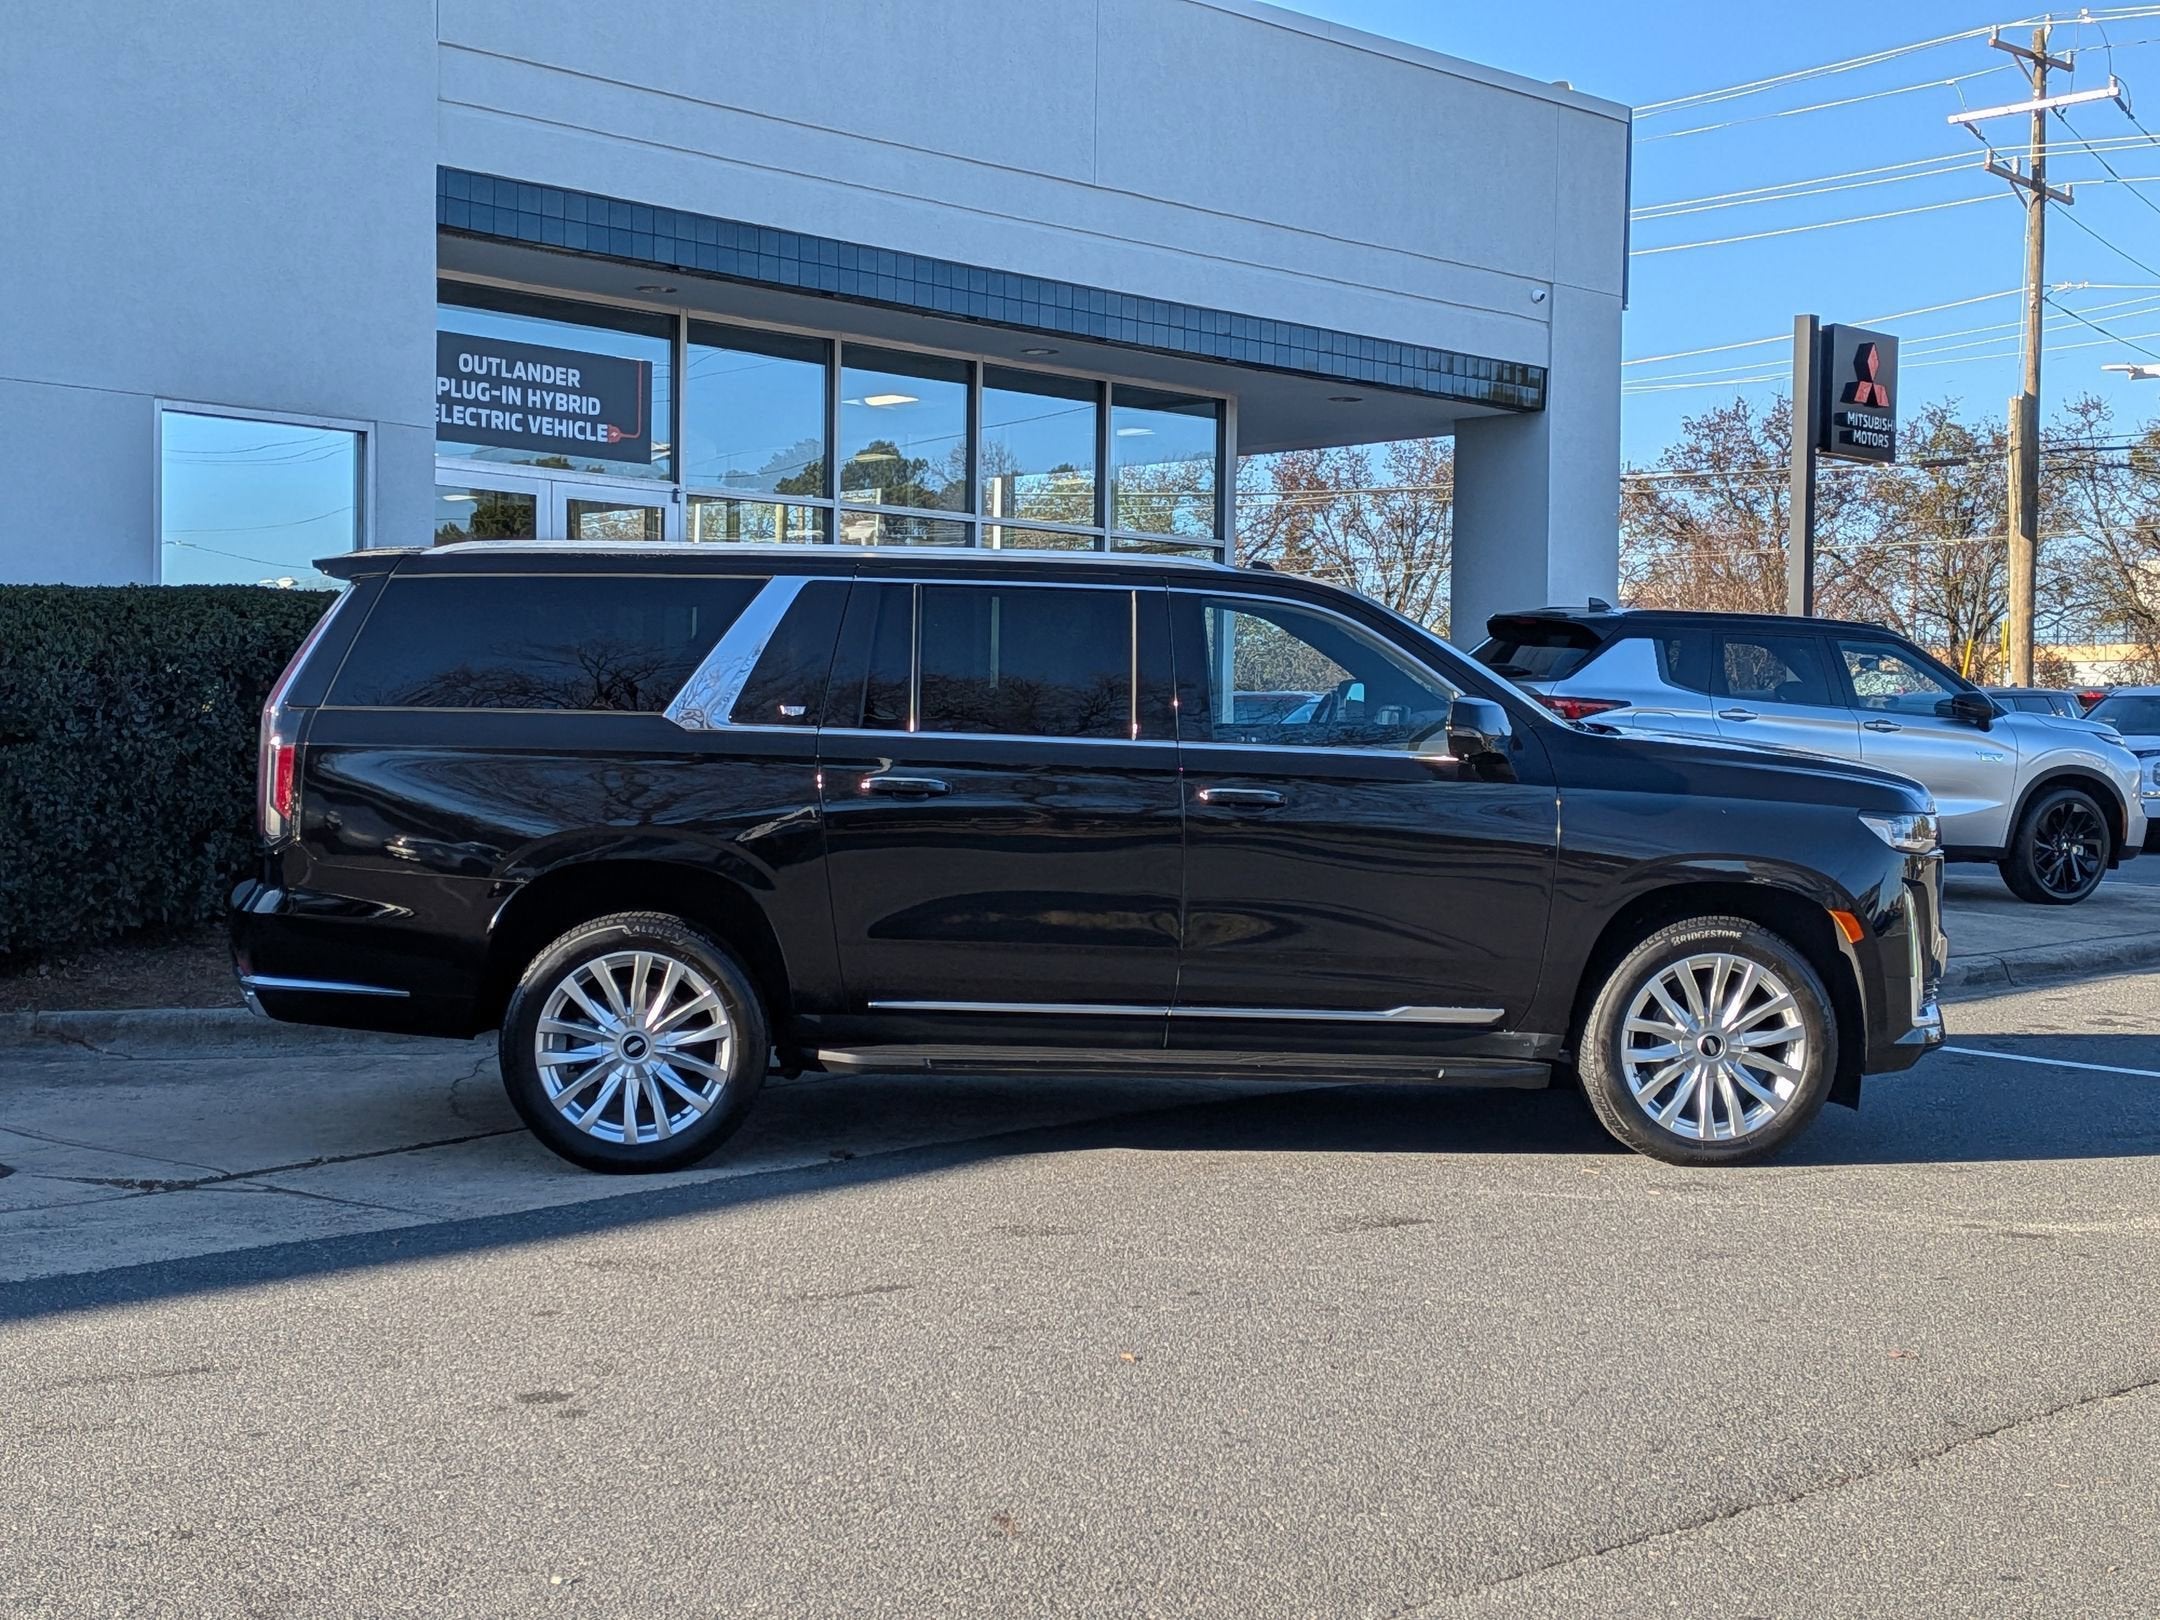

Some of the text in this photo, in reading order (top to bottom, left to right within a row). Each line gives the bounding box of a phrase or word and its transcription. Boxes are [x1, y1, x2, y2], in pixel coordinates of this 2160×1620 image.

[458, 352, 581, 389] OUTLANDER
[436, 376, 601, 416] PLUG-IN HYBRID
[527, 414, 609, 443] VEHICLE
[1853, 429, 1890, 448] MOTORS
[1670, 929, 1743, 947] BRIDGESTONE
